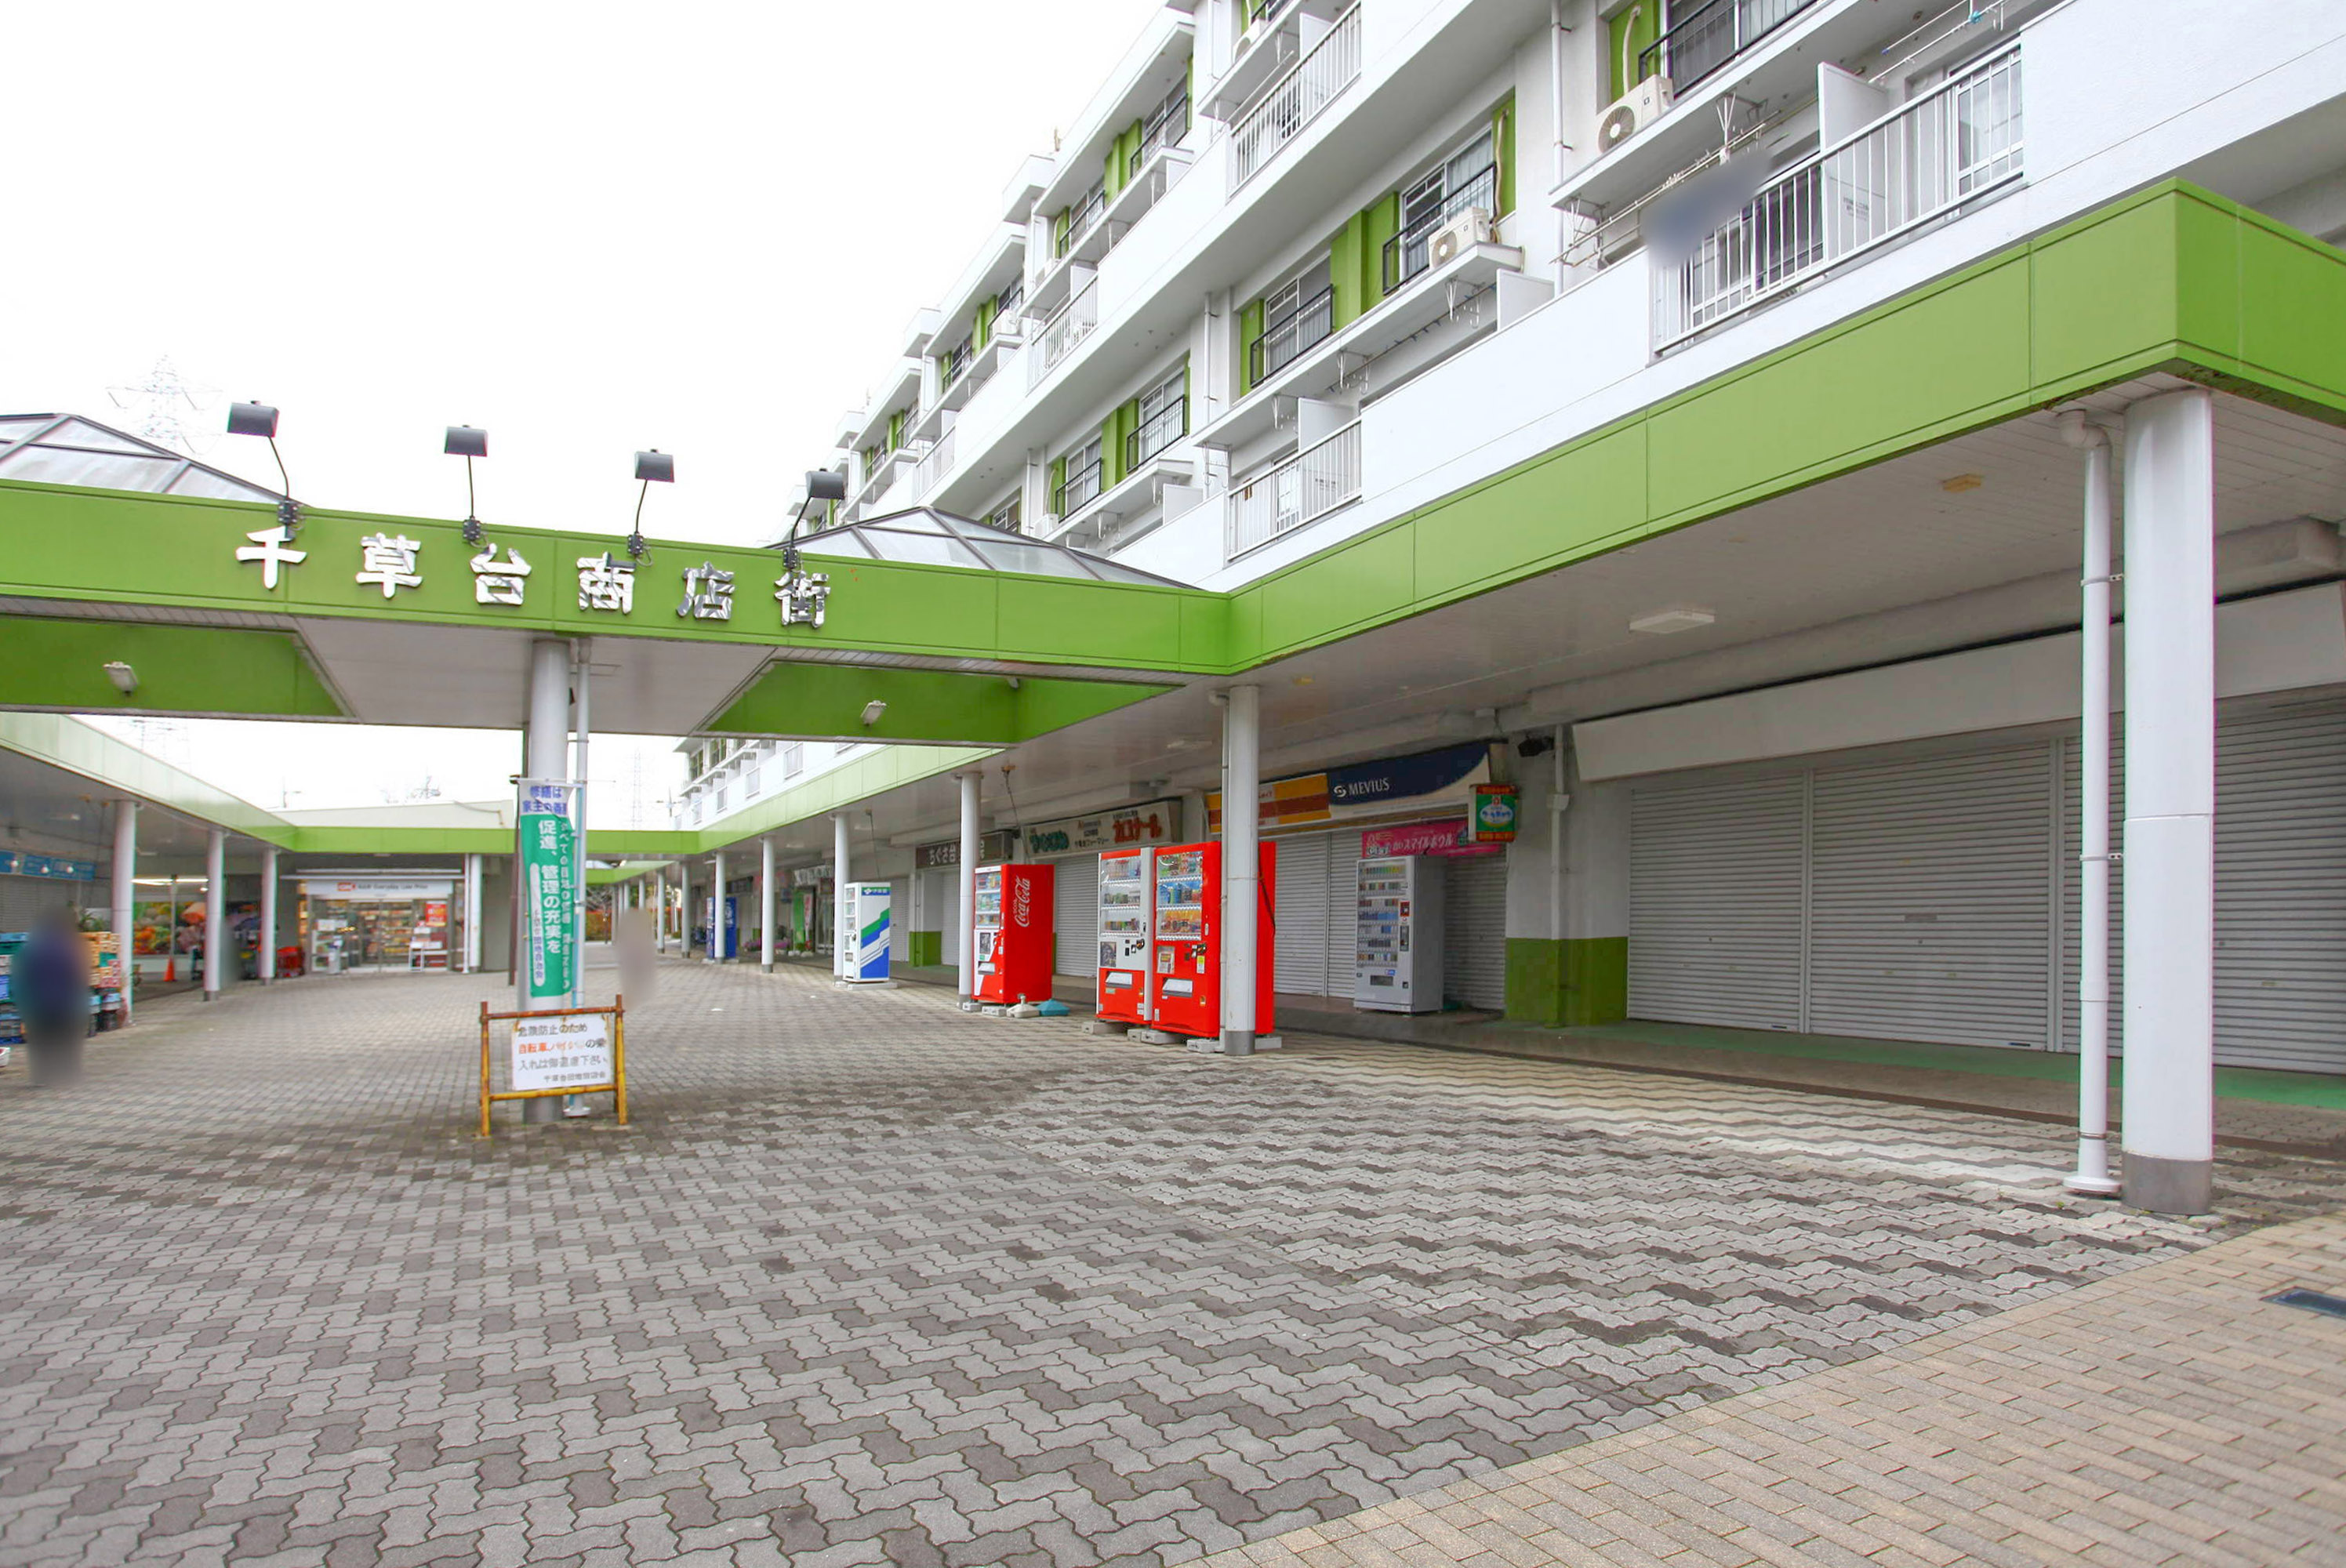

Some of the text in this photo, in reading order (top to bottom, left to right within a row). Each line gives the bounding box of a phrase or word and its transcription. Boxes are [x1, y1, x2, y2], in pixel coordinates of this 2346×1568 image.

[235, 524, 832, 629] 千草台商店街
[1349, 777, 1391, 796] MEVIUS
